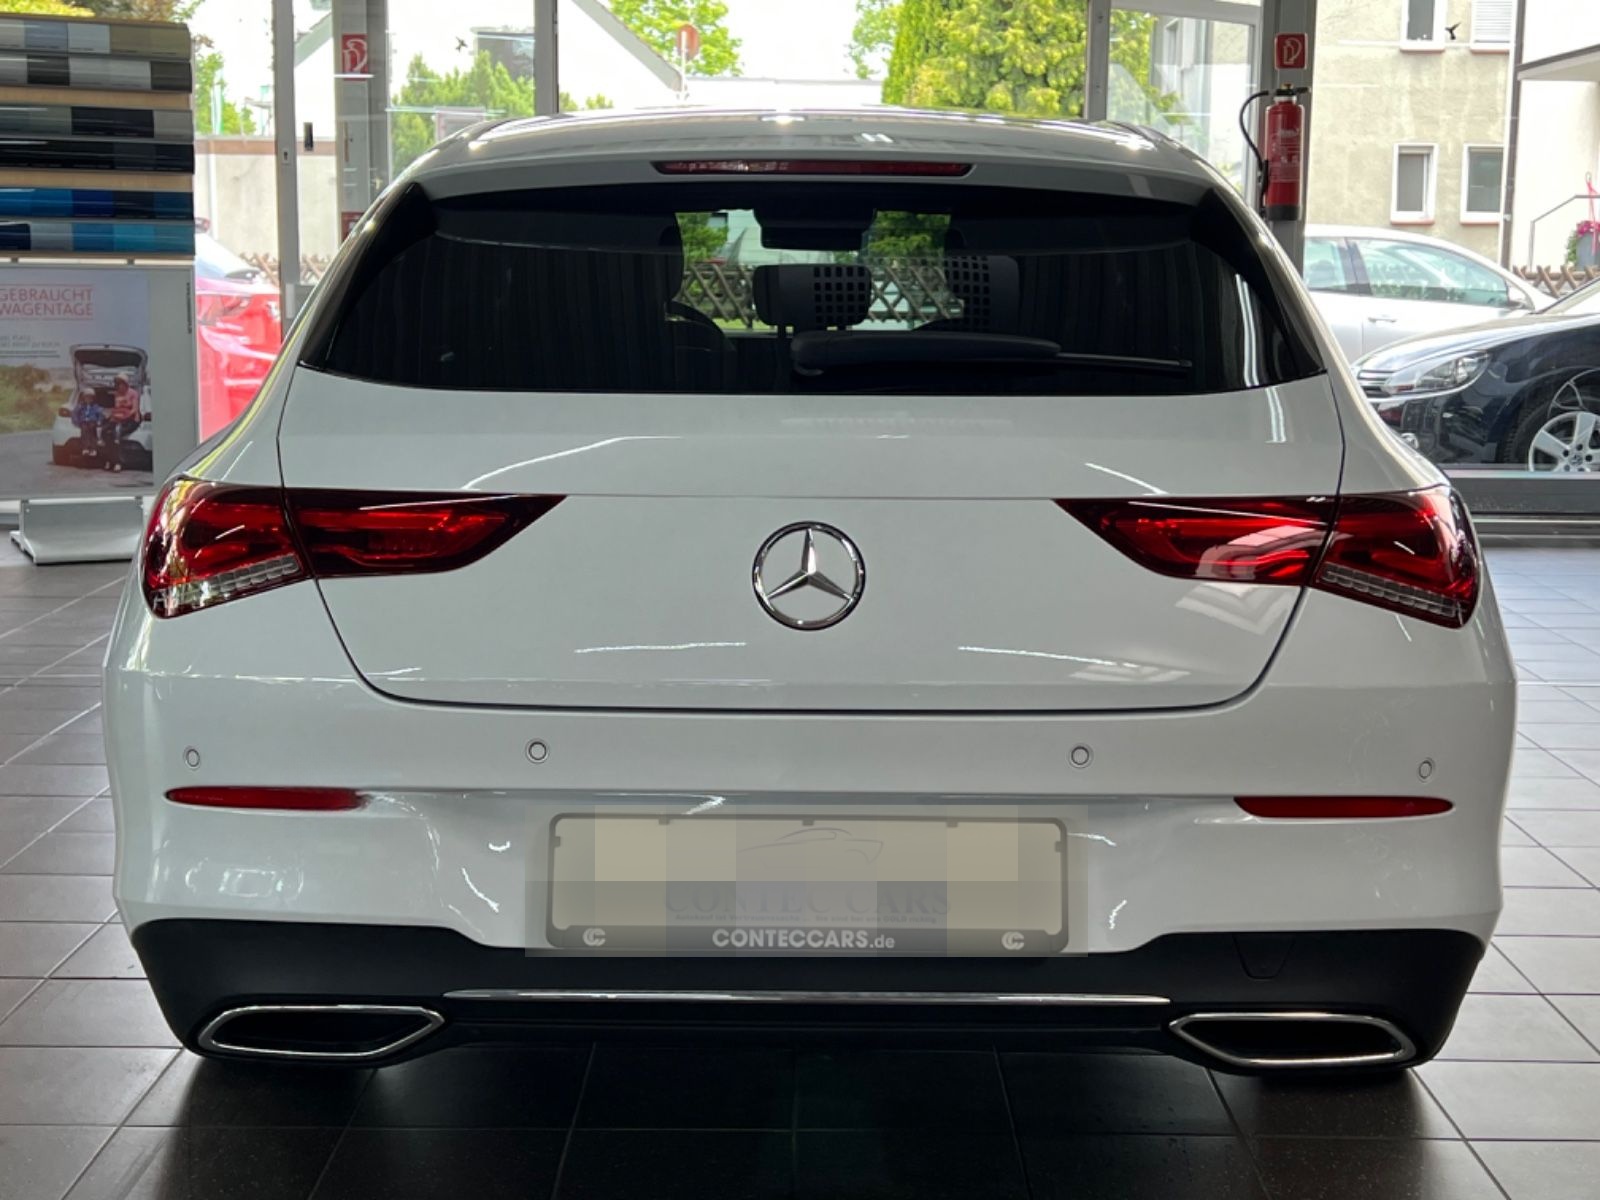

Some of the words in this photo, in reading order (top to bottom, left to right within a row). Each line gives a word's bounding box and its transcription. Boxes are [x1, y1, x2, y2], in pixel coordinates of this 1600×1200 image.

[0, 288, 93, 301] GEBRAUCHT
[0, 302, 93, 316] WAGENTAGE
[664, 884, 832, 913] CONTEC
[845, 885, 951, 915] CARS
[712, 928, 895, 948] CONTECCARS.de
